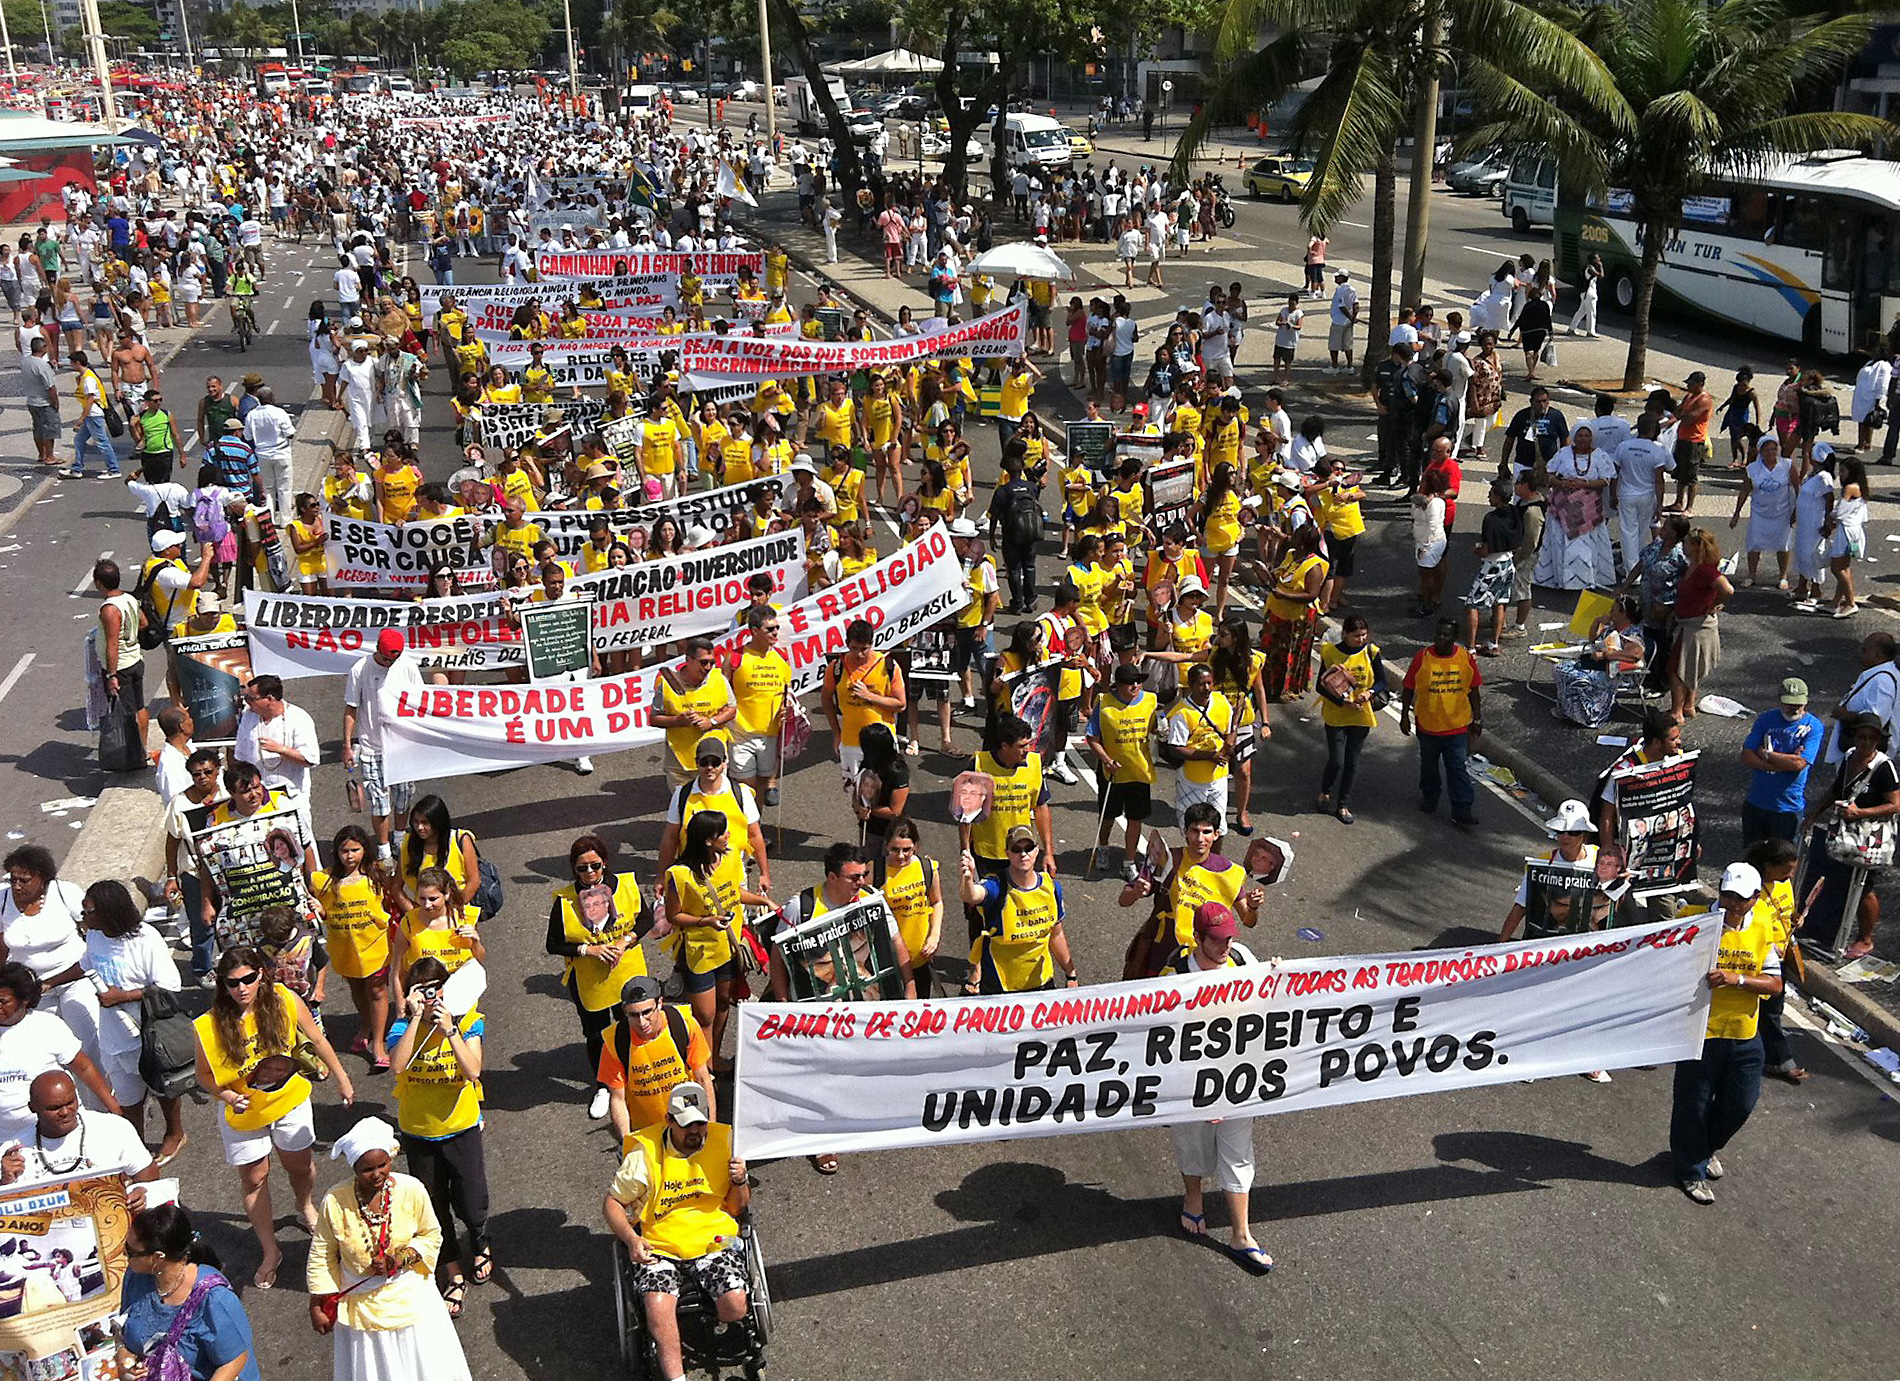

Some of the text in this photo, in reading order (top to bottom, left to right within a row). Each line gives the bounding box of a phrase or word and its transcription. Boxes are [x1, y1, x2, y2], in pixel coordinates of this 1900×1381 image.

[1694, 243, 1722, 260] TUR
[539, 254, 639, 276] CAMINHANO
[641, 254, 650, 275] A
[654, 254, 692, 274] GENT
[694, 254, 709, 274] SE
[423, 289, 430, 297] A
[494, 286, 539, 296] RELIGIOSA
[541, 285, 567, 294] AINDA
[617, 274, 668, 287] PRINCIPAIS
[485, 304, 514, 319] QUE
[605, 298, 634, 310] ELA
[682, 338, 724, 356] SEJA
[726, 340, 738, 356] A
[743, 342, 775, 359] VOZ
[780, 344, 812, 360] DOS
[815, 347, 846, 362] QUE
[851, 343, 915, 362] SOFREM
[329, 519, 342, 541] E
[346, 522, 379, 547] SE
[385, 518, 473, 549] VOCÊ
[679, 478, 784, 517] ESTUDR
[344, 544, 487, 572] POR CAUSA
[254, 598, 403, 630] LIBERDADE
[406, 601, 507, 627] RESPEIT
[681, 536, 799, 583] DIVERSIDADE
[396, 531, 948, 718] LIBERDADE DE É RELIGIÃO
[874, 626, 896, 649] DO
[897, 589, 959, 635] BRASIL
[284, 625, 364, 653] NÃO
[496, 647, 521, 664] DO
[610, 623, 673, 646] FEDERAL
[506, 715, 526, 744] É
[535, 716, 595, 743] UM
[1538, 870, 1564, 887] crime
[1016, 904, 1049, 917] Libertem
[791, 936, 818, 953] crime
[817, 921, 852, 949] praticar
[867, 905, 883, 924] Fé?
[1717, 946, 1731, 959] oje,
[1746, 960, 1757, 971] de
[864, 1010, 898, 1040] DE
[900, 1002, 948, 1039] SÃO
[953, 1003, 1026, 1035] PAULO
[1031, 988, 1182, 1029] CAMINHANDO
[1185, 978, 1255, 1010] JUNTO
[1258, 972, 1283, 1000] C/
[1285, 969, 1348, 997] TODAS
[1352, 965, 1380, 990] AS
[1385, 951, 1498, 988] TRADIÇÕES
[1636, 925, 1702, 951] PELA
[1014, 996, 1422, 1080] PAZ, RESPEITO E
[631, 1054, 677, 1075] Hoje, somos
[633, 1066, 683, 1087] seguidores de
[921, 1030, 1510, 1132] UNIDADE DOS POVOS.
[652, 1087, 661, 1097] as
[663, 1180, 683, 1193] Hoje,
[28, 1193, 67, 1211] OXUM
[7, 1219, 46, 1233] ANOS
